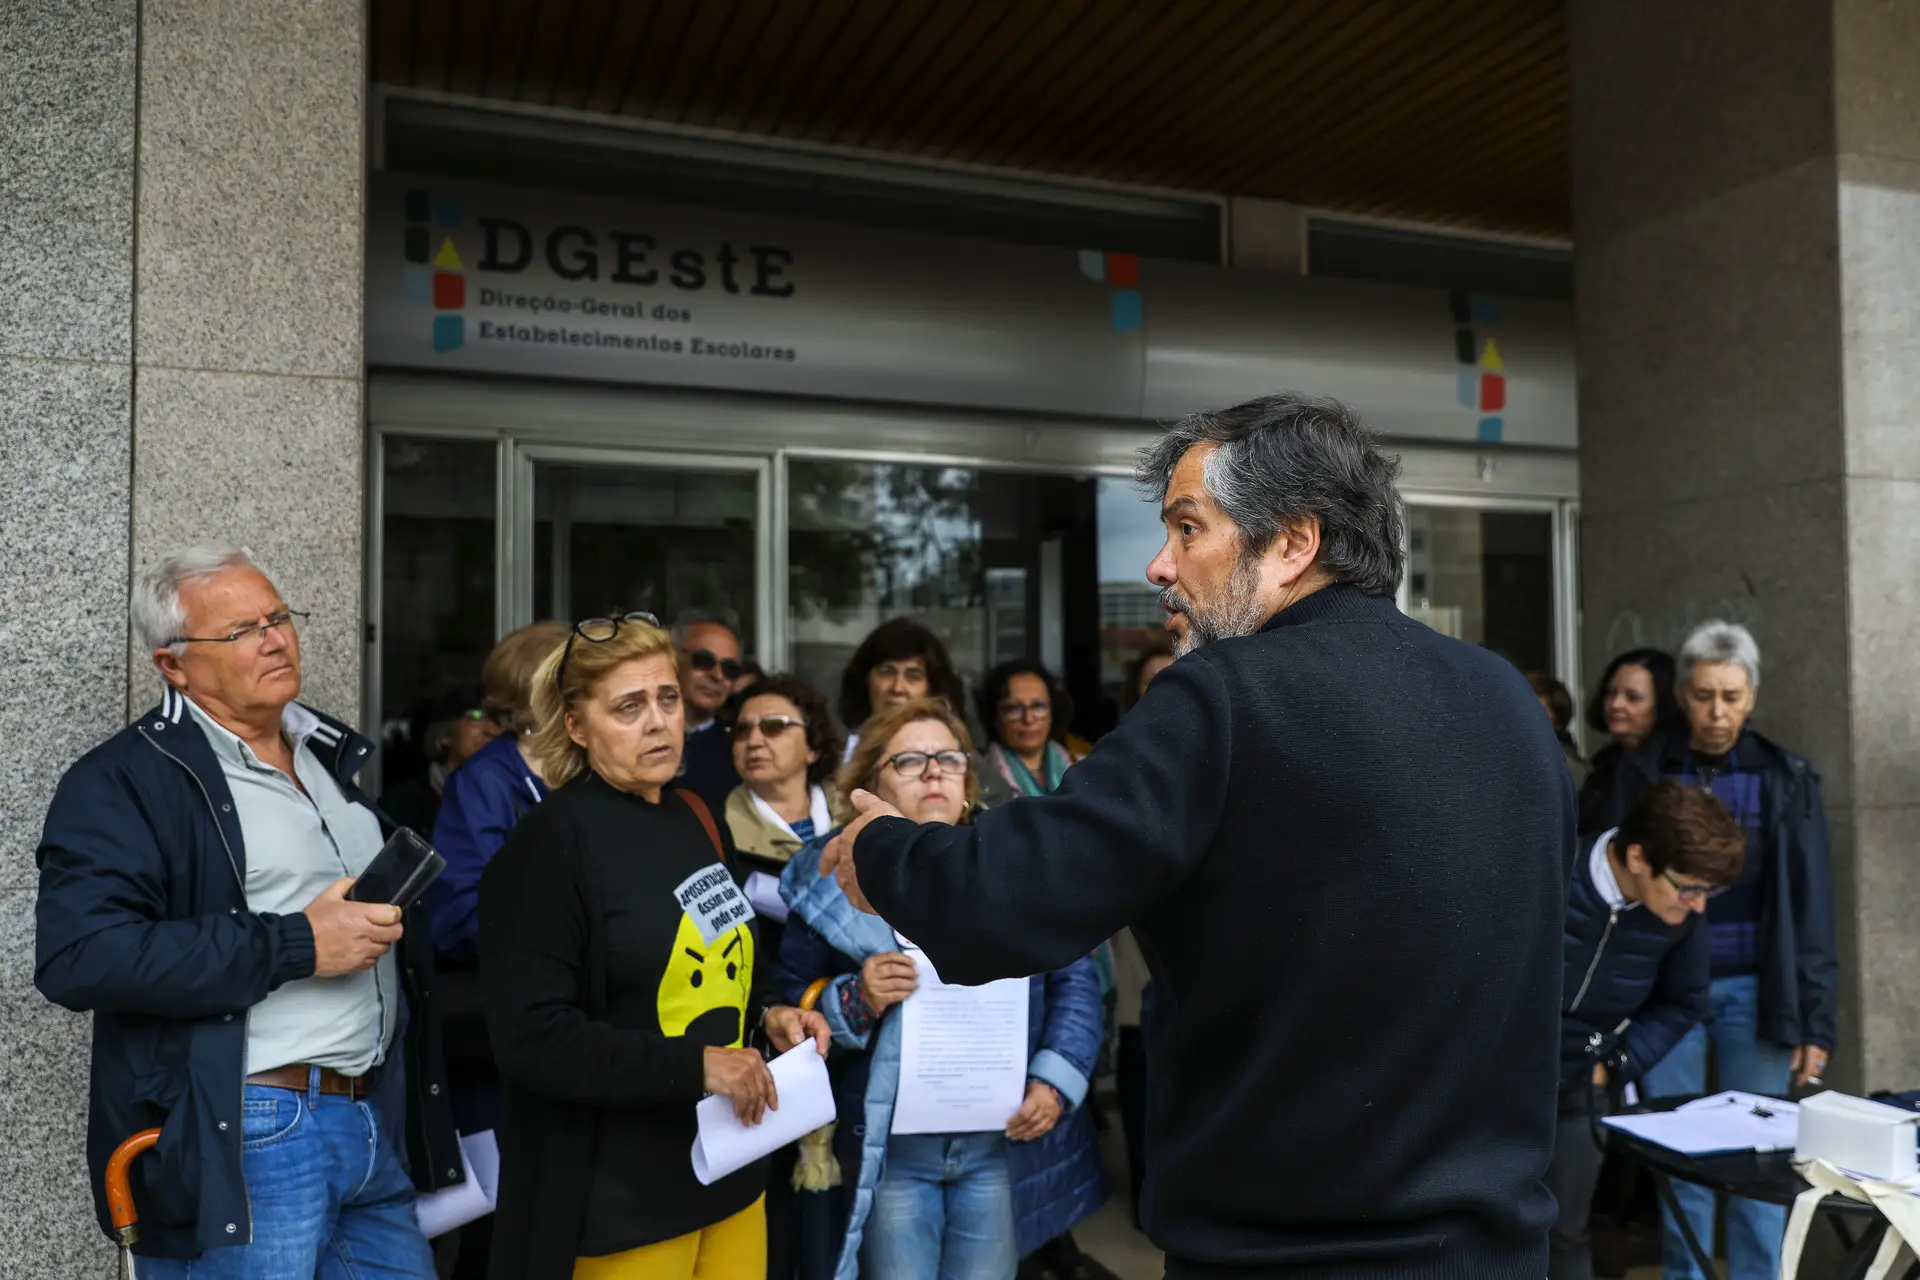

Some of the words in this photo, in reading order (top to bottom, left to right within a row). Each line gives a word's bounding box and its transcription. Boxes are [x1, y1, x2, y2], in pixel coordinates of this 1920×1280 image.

[477, 216, 797, 298] DGEstE
[479, 287, 645, 321] Direção-Geral
[652, 304, 692, 323] dos
[478, 320, 684, 355] Estabelecimentos
[690, 337, 797, 362] Escolares
[711, 909, 733, 933] pode
